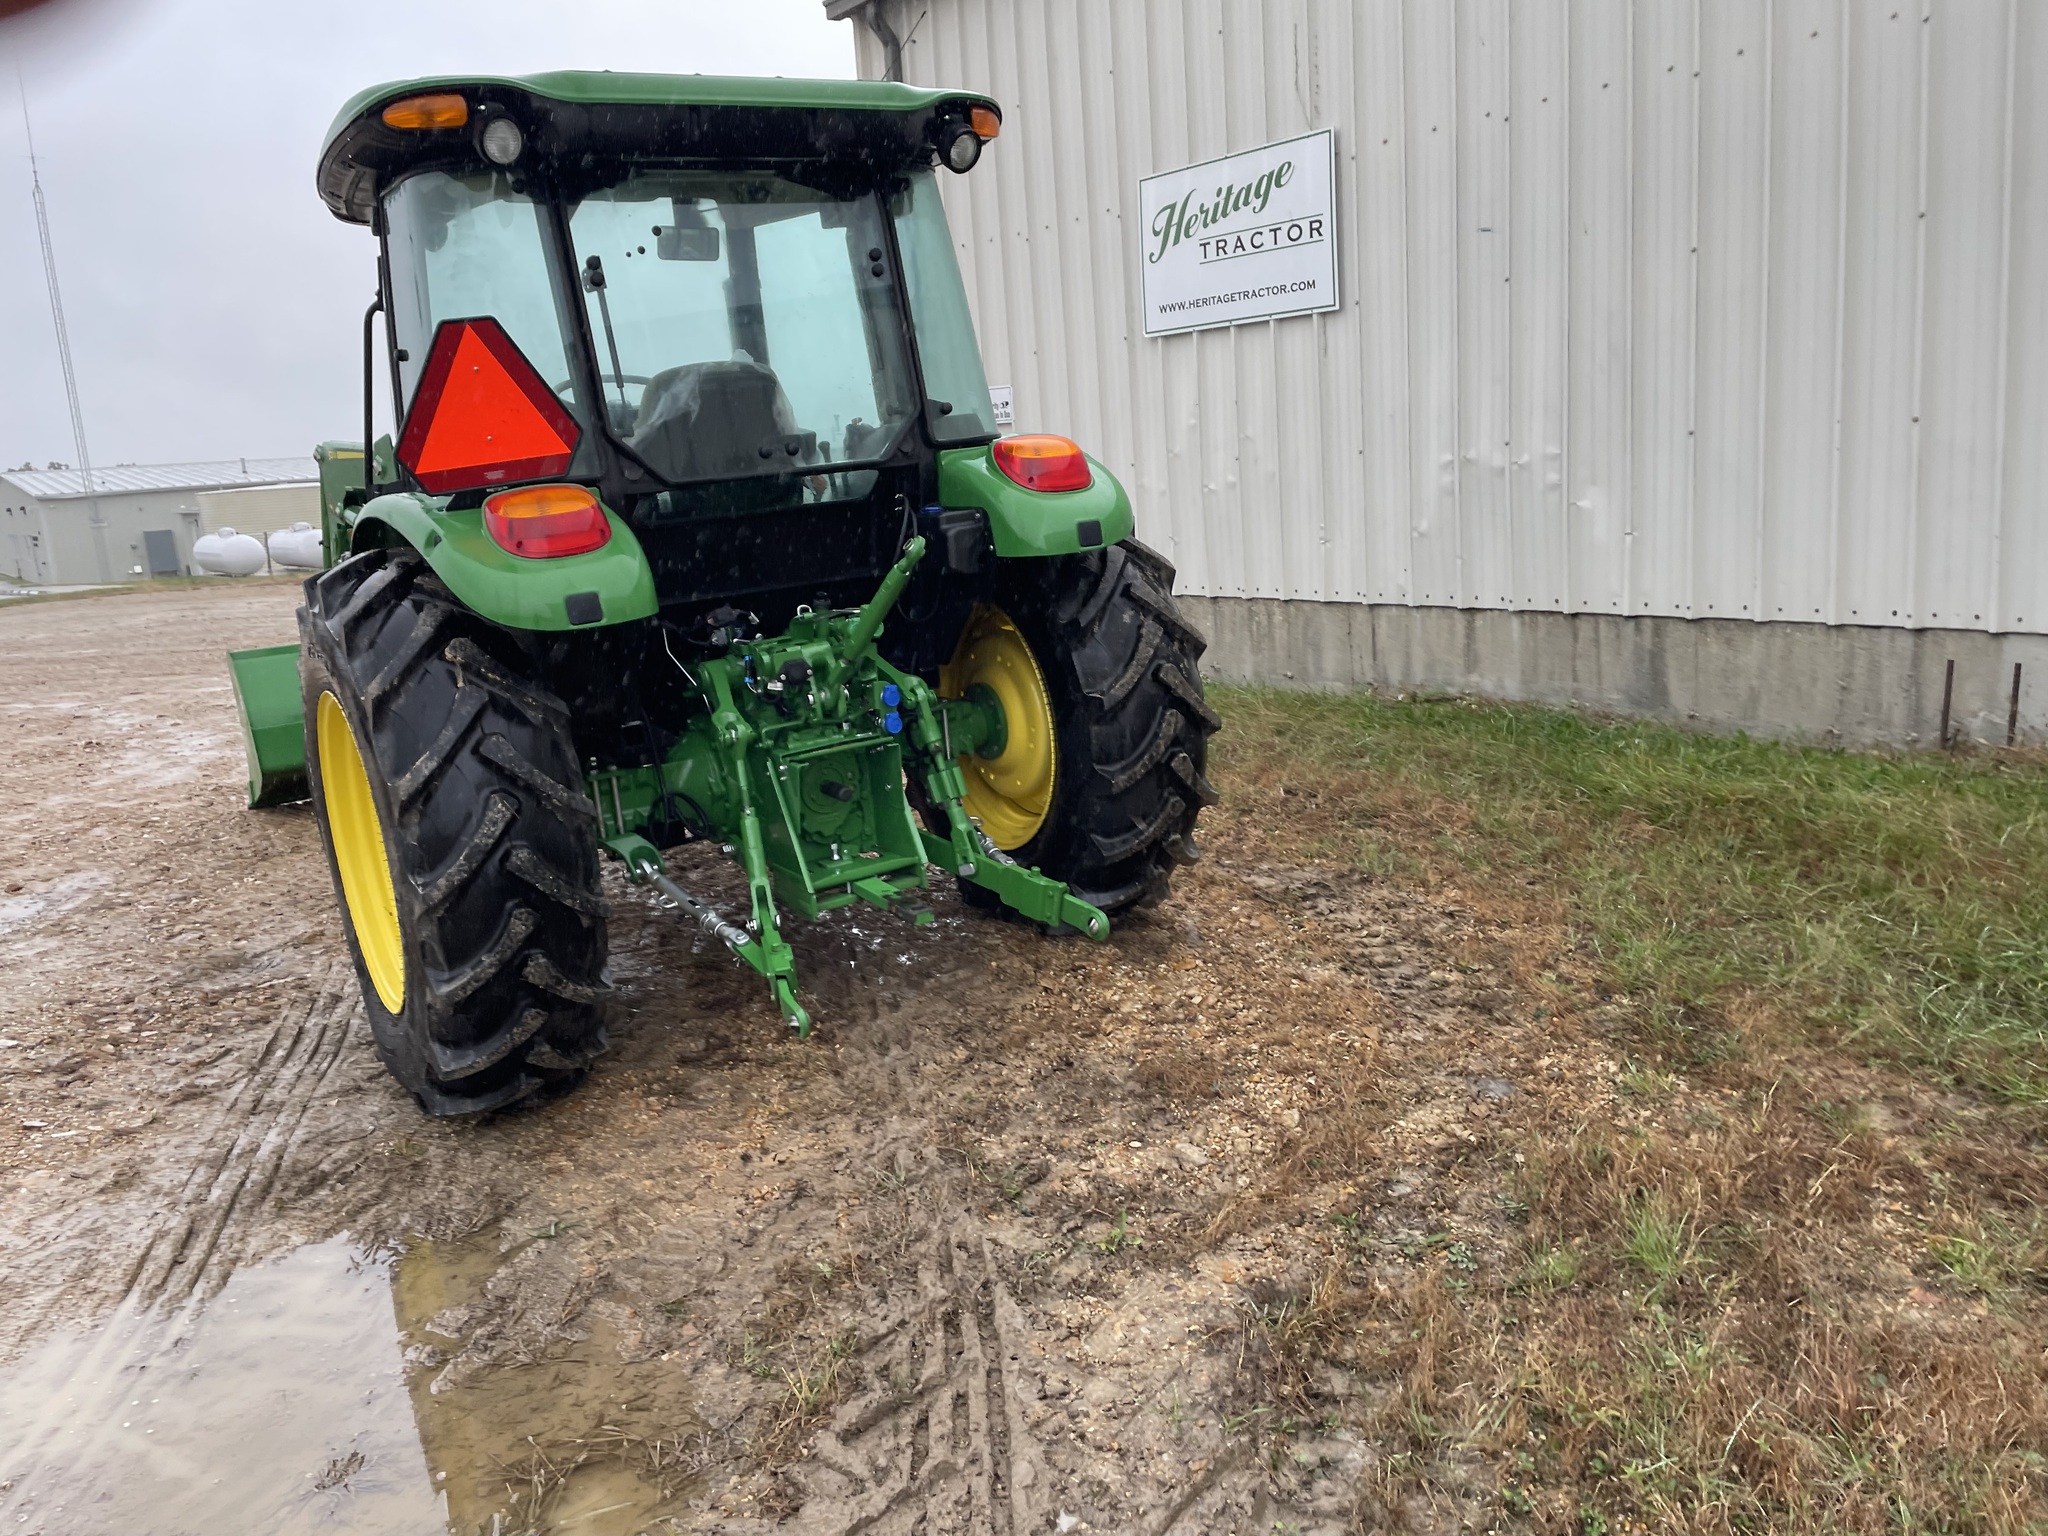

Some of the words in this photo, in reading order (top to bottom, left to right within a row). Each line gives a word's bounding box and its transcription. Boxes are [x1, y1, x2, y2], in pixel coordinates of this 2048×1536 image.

[1149, 160, 1295, 264] Heritage
[1199, 219, 1324, 259] TRACTOR
[1158, 279, 1316, 314] WWW.HERITAGETRACTOR.COM
